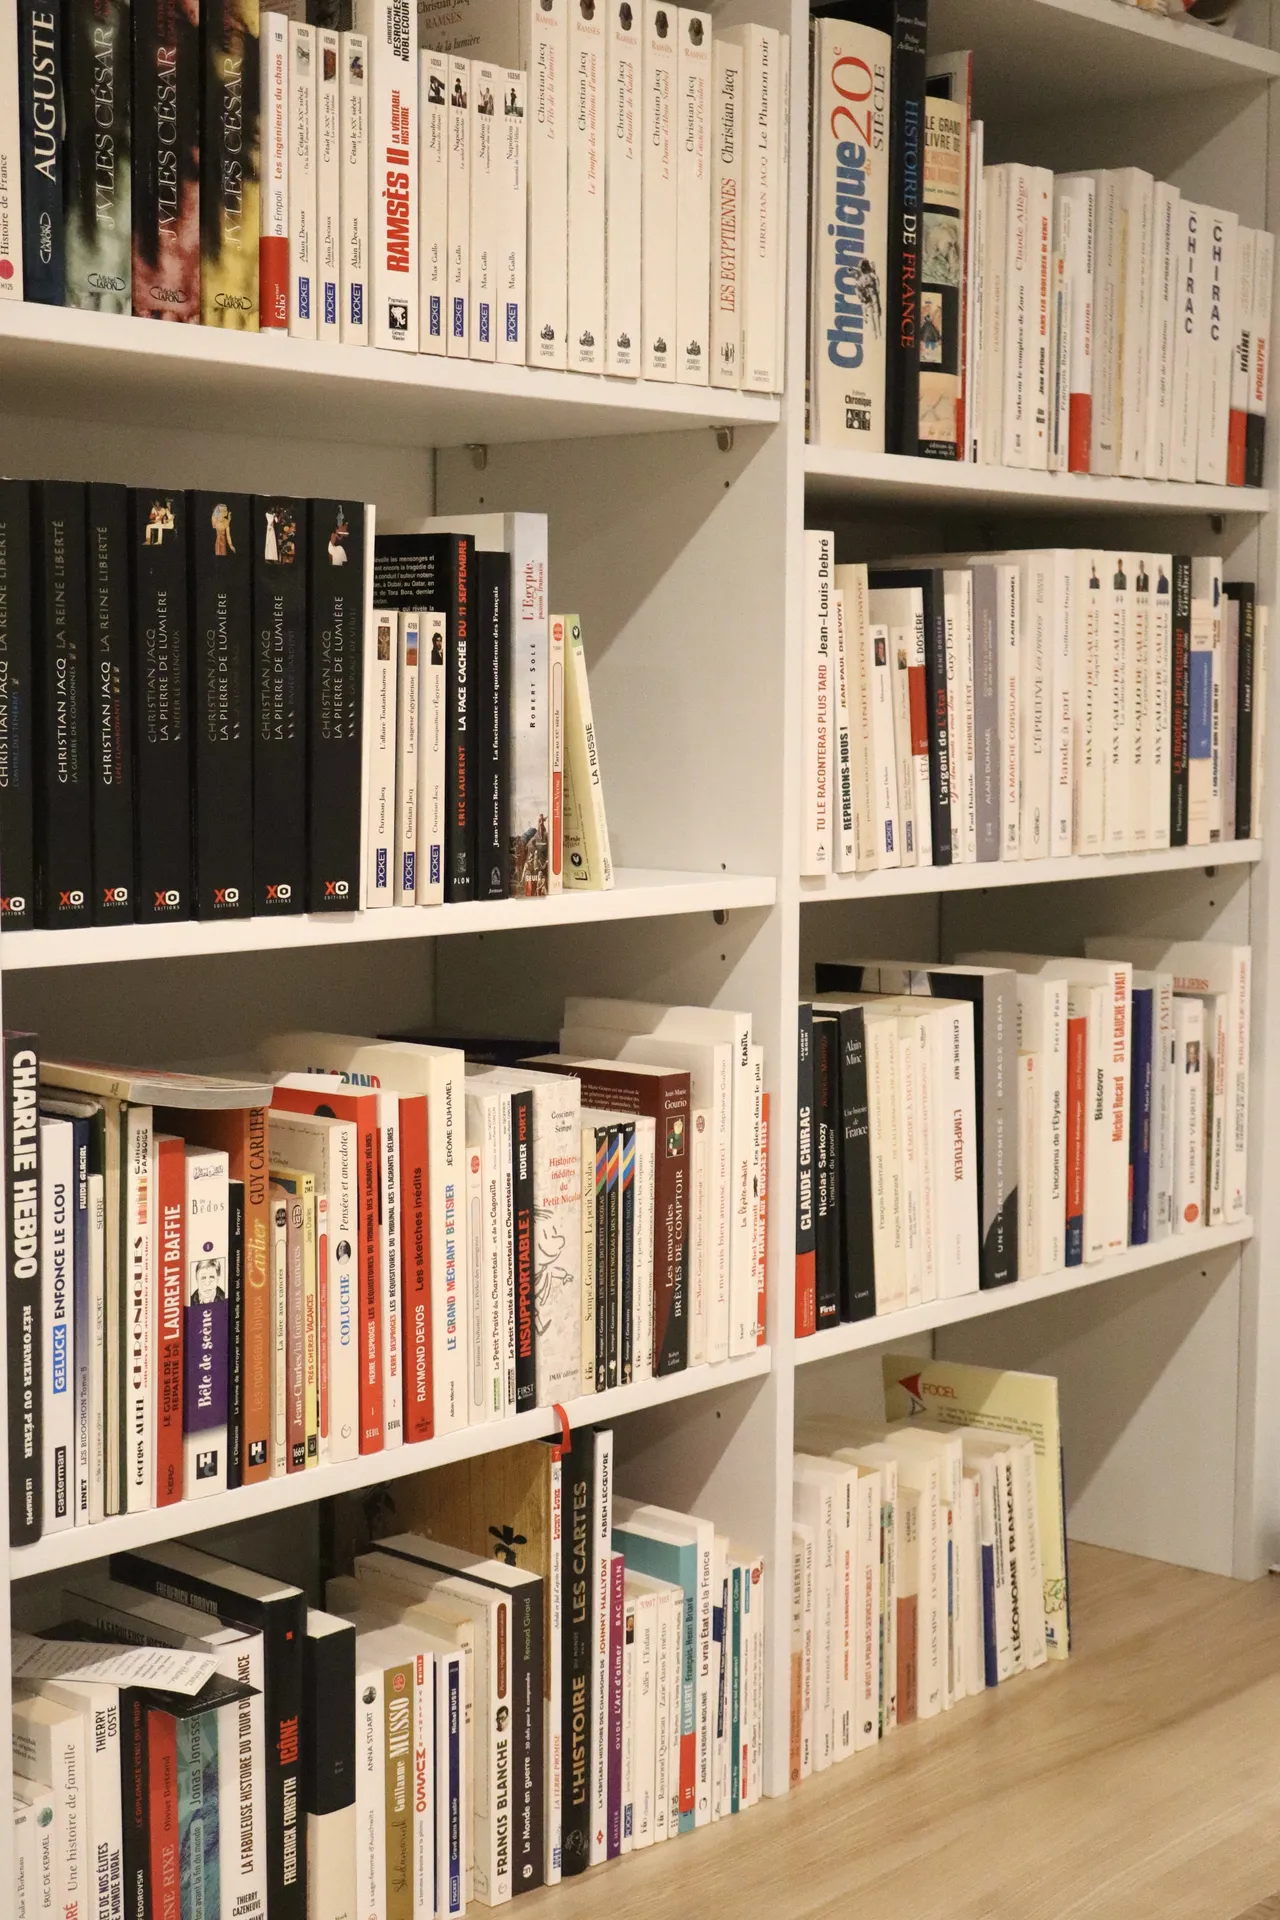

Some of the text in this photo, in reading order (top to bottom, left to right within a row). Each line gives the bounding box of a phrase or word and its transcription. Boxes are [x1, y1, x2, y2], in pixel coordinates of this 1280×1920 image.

[400, 0, 409, 62] NOBLECOUR
[760, 38, 769, 66] noir
[32, 11, 56, 183] AUGUSTE
[91, 27, 113, 128] CÉSAR
[274, 54, 282, 85] chaos
[275, 87, 282, 100] du
[759, 70, 769, 126] Pharaon
[273, 103, 284, 158] ingénieurs
[391, 90, 400, 144] LA VÉRITABLE
[400, 106, 409, 145] HISTOIRE
[429, 113, 438, 148] Napoléon
[721, 69, 737, 164] Christian Jacq
[759, 130, 768, 149] Le
[871, 64, 886, 151] SIÈCLE
[760, 156, 768, 189] JACQ
[383, 148, 409, 273] RAMSÈS II
[721, 178, 737, 312] LES EGYPTIENNES
[900, 100, 918, 348] HISTOIRE DE FRANCE
[430, 243, 438, 262] Gallo
[826, 140, 870, 368] Chronique
[1015, 226, 1023, 271] Claude
[300, 277, 308, 318] POCKET
[430, 296, 439, 335] POCKET
[1255, 338, 1265, 401] APOCALYPSE
[51, 520, 65, 649] LA REINE LIBERTÉ
[492, 586, 501, 622] Français
[155, 591, 168, 741] LA PIERRE DE LUMIÈRE
[457, 540, 467, 730] LA FACE CACHÉE DU 11 SEPTEMBRE
[492, 640, 500, 689] quotidienne
[528, 643, 536, 672] SOLÉ
[57, 658, 68, 783] CHRISTIAN JACQ
[379, 668, 388, 721] Toutankhamon
[817, 539, 829, 831] TU LE RACONTERAS PLUS TARD Jean-Louis Debré
[379, 723, 387, 750] L'affaire
[492, 751, 499, 760] La
[585, 723, 600, 785] LA RUSSIE
[938, 730, 946, 746] de
[379, 787, 387, 804] Jacq
[458, 746, 466, 826] ERIC LAURENT
[840, 734, 852, 830] REPRENONS-NOUS
[938, 751, 949, 805] L'argent
[1112, 972, 1125, 1142] Michel Rocard SI LA GAUCHE SAVAIT
[445, 1080, 453, 1127] DUHAMEL
[13, 1050, 38, 1278] CHARLIE HEBDO
[250, 1106, 265, 1205] GUY CARLIER
[549, 1156, 578, 1168] Histoires
[551, 1170, 576, 1180] inédites
[800, 1106, 811, 1230] CLAUDE CHIRAC
[818, 1122, 828, 1216] Nicolas Sarkozy
[954, 1109, 965, 1181] L'IMPÉTUEUX
[1053, 1134, 1060, 1147] de
[338, 1131, 349, 1231] Pensées et anecdotes
[665, 1204, 674, 1262] nouvelles
[671, 1170, 683, 1317] BRÈVES DE COMPTOIR
[54, 1184, 66, 1391] GELUCK ENFONCE LE CLOU
[164, 1204, 180, 1339] LAURENT BAFFIE
[413, 1168, 426, 1402] RAYMOND DEVOS Les sketches inédits
[519, 1219, 531, 1356] INSUPPORTABLE
[339, 1274, 350, 1345] COLUCHE
[447, 1295, 456, 1333] GRAND
[447, 1336, 456, 1351] LE
[21, 1305, 35, 1458] RÉFORMER OU PÉRIR
[196, 1310, 213, 1409] Bête de scène
[922, 1383, 958, 1399] FOCEL
[56, 1449, 64, 1514] casterman
[573, 1482, 586, 1623] LES CARTES
[824, 1496, 833, 1568] Jacques Attali
[599, 1613, 607, 1655] JOHNNY
[699, 1552, 710, 1676] Le vrai État de la France
[613, 1645, 623, 1714] L'Art d'aimer
[96, 1711, 106, 1752] THIERRY
[108, 1706, 116, 1737] COSTE
[390, 1697, 410, 1812] Guillaume MUSSO
[568, 1675, 585, 1805] L'HISTOIRE
[64, 1744, 78, 1891] Une histoire de famille
[239, 1711, 254, 1874] LA FABULEUSE HISTOIRE DU TOUR
[277, 1716, 298, 1885] FREDERICK FORSYTH ICÔNE
[496, 1740, 508, 1876] FRANCIS BLANCHE
[522, 1757, 532, 1853] Le Monde en guerre
